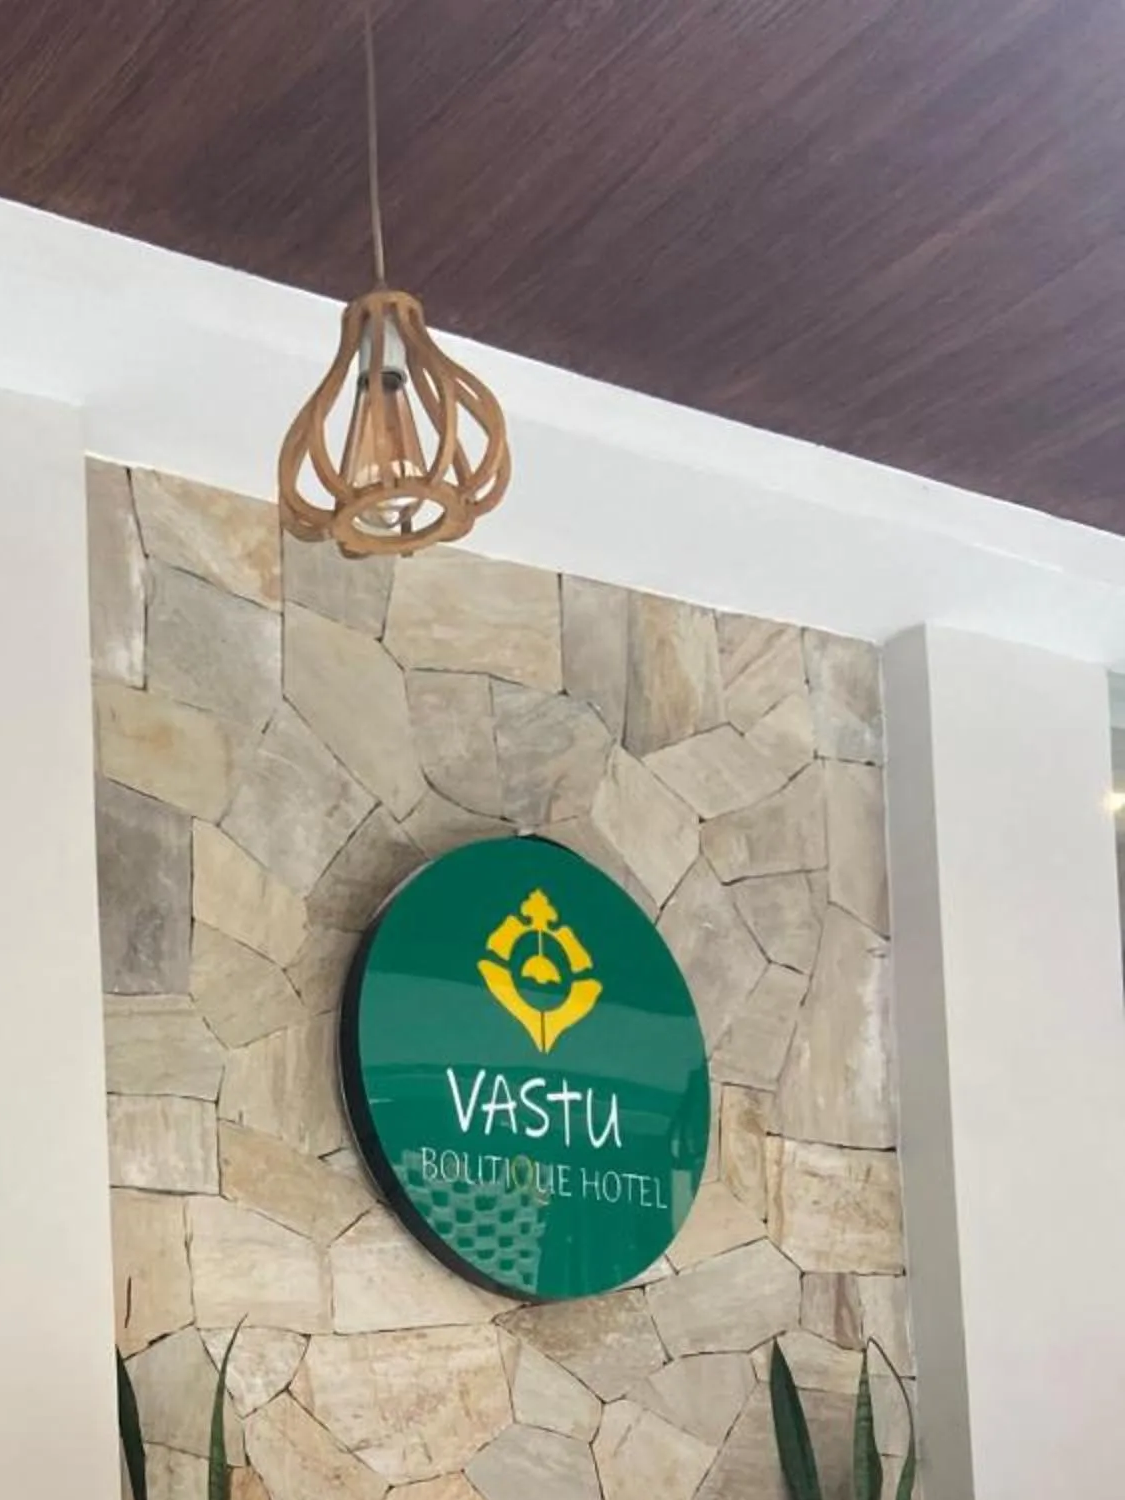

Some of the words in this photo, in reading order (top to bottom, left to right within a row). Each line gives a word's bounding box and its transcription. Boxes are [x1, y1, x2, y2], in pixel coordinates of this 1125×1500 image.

[446, 1067, 622, 1148] VASTU
[421, 1147, 572, 1197] BOUTIQUE
[581, 1167, 668, 1209] HOTEL
